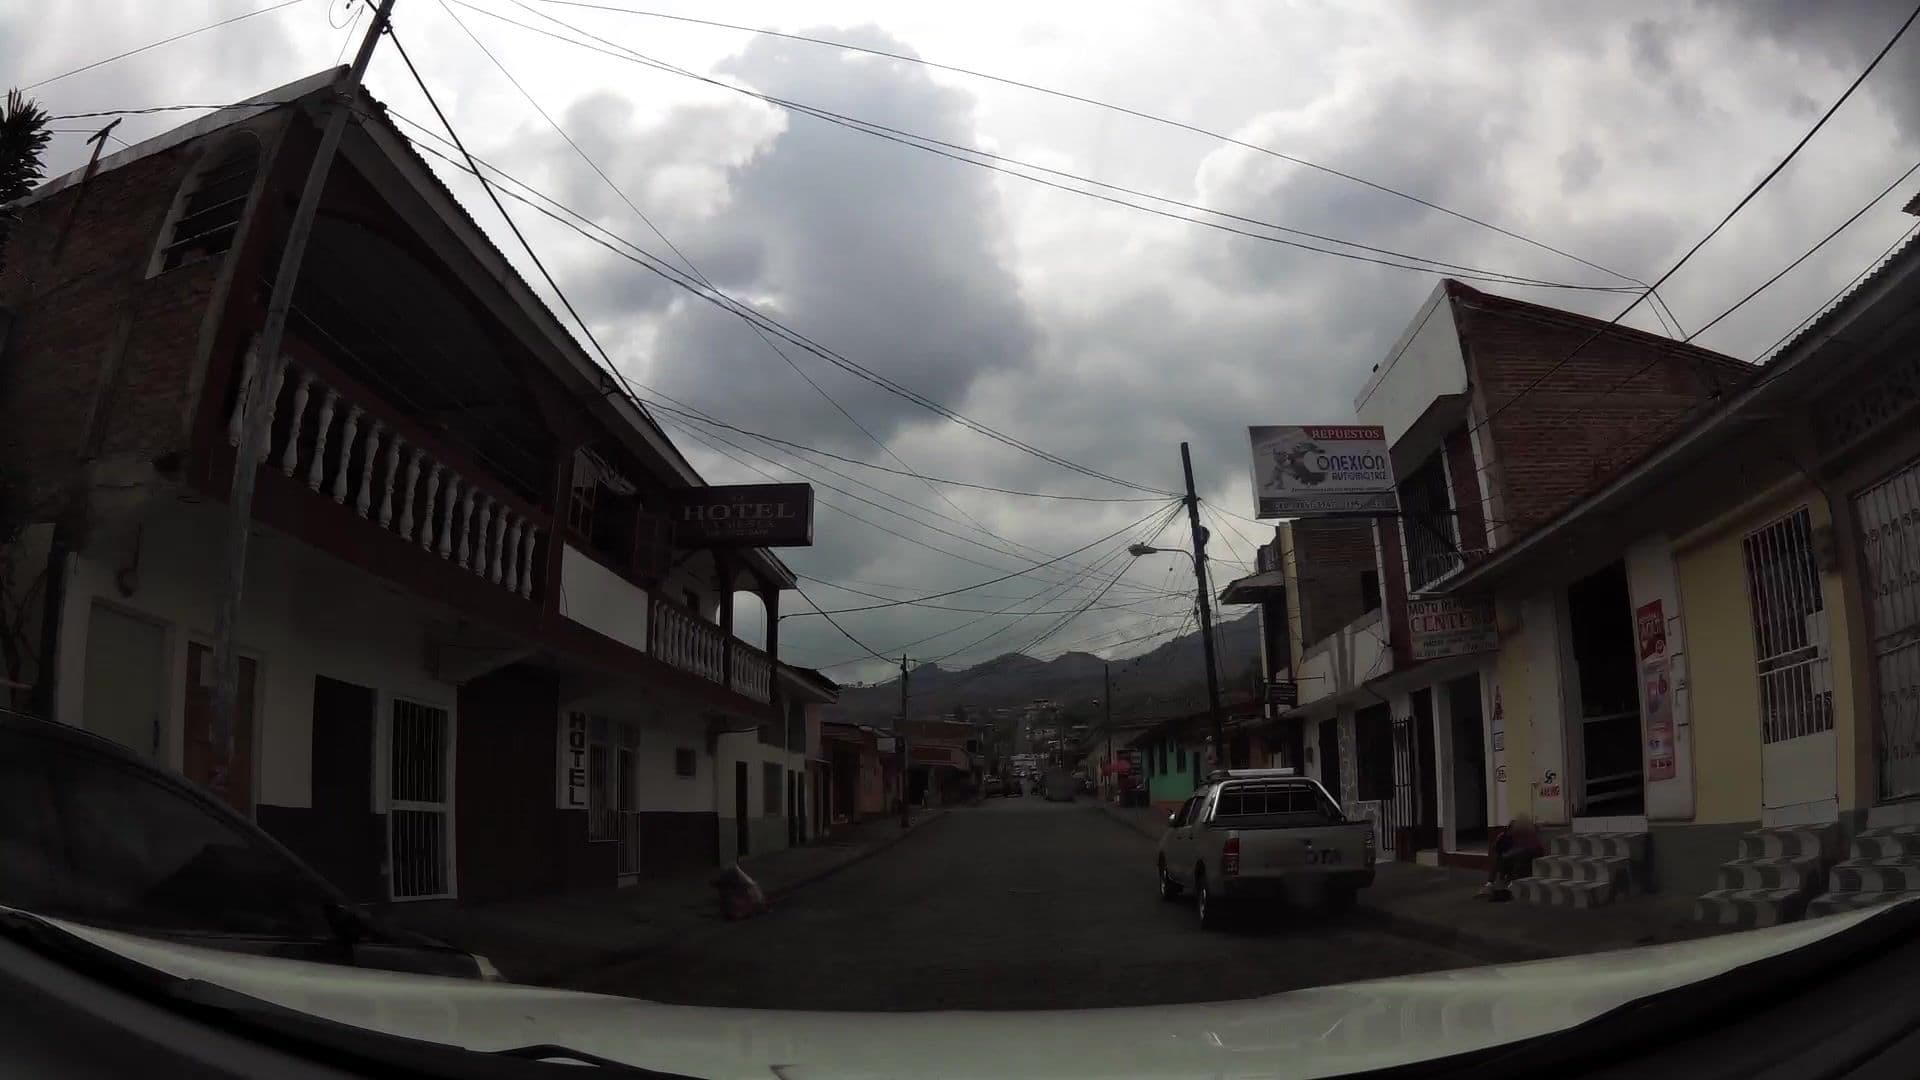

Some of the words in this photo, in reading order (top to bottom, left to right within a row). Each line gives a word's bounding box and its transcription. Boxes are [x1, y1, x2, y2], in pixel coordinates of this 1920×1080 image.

[1311, 428, 1380, 440] REPUESTOS
[682, 502, 797, 521] HOTEL
[569, 711, 586, 805] HOTEL
